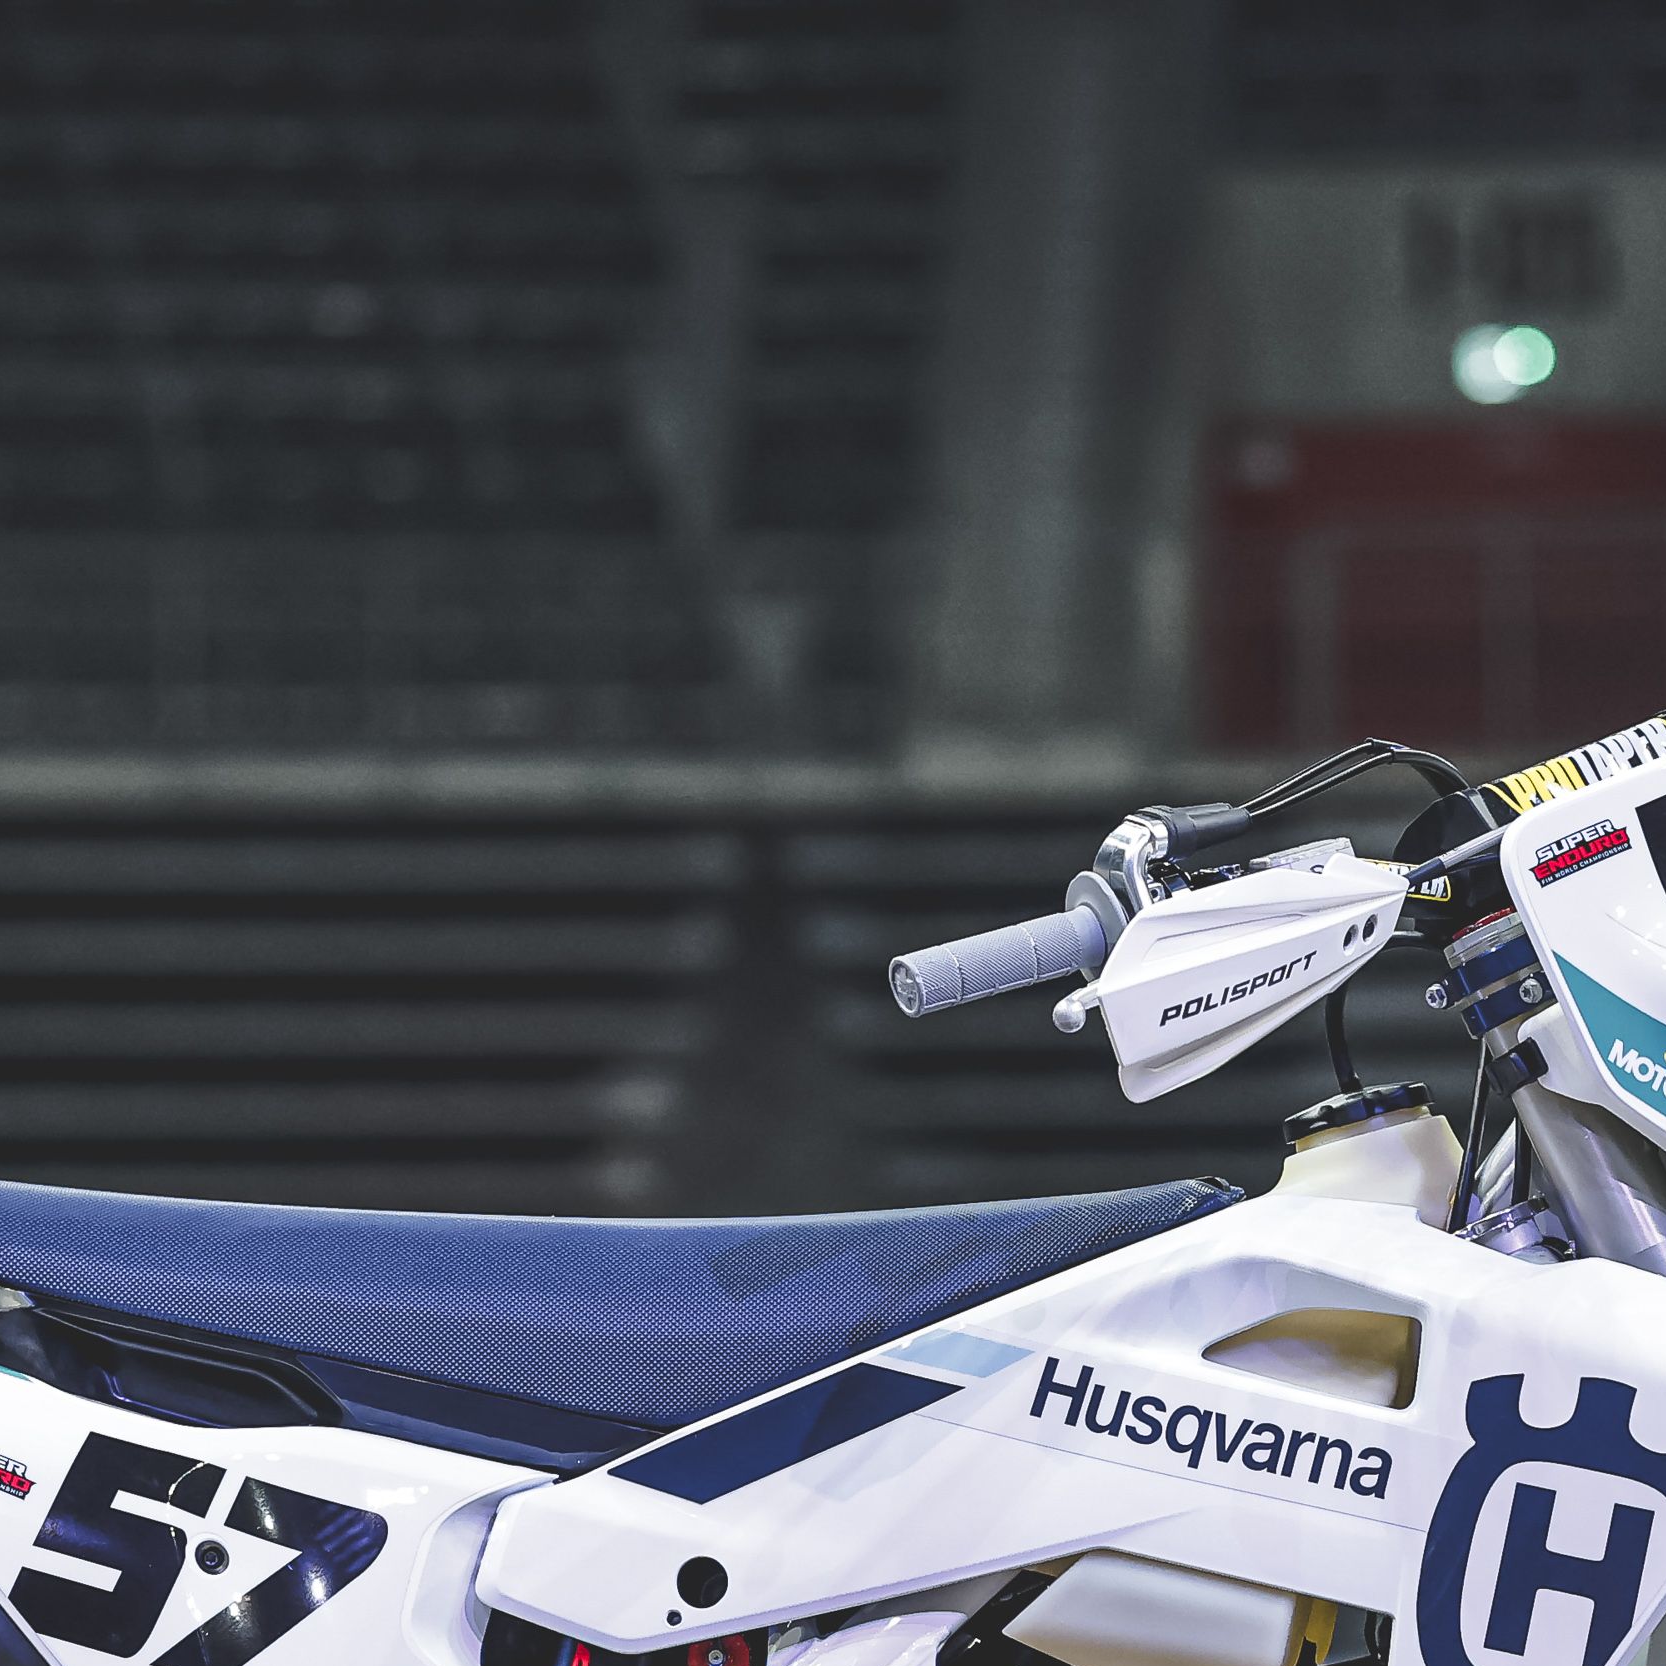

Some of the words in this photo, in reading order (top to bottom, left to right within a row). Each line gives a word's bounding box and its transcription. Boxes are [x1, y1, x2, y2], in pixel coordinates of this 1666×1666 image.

[1534, 829, 1629, 879] ENDURO
[1536, 821, 1614, 863] SUPER
[1555, 864, 1579, 879] WORLD
[1579, 842, 1629, 867] CHAMPIONSHIP
[1160, 950, 1317, 1026] POLISPORT
[1029, 1356, 1394, 1500] Husqvarna
